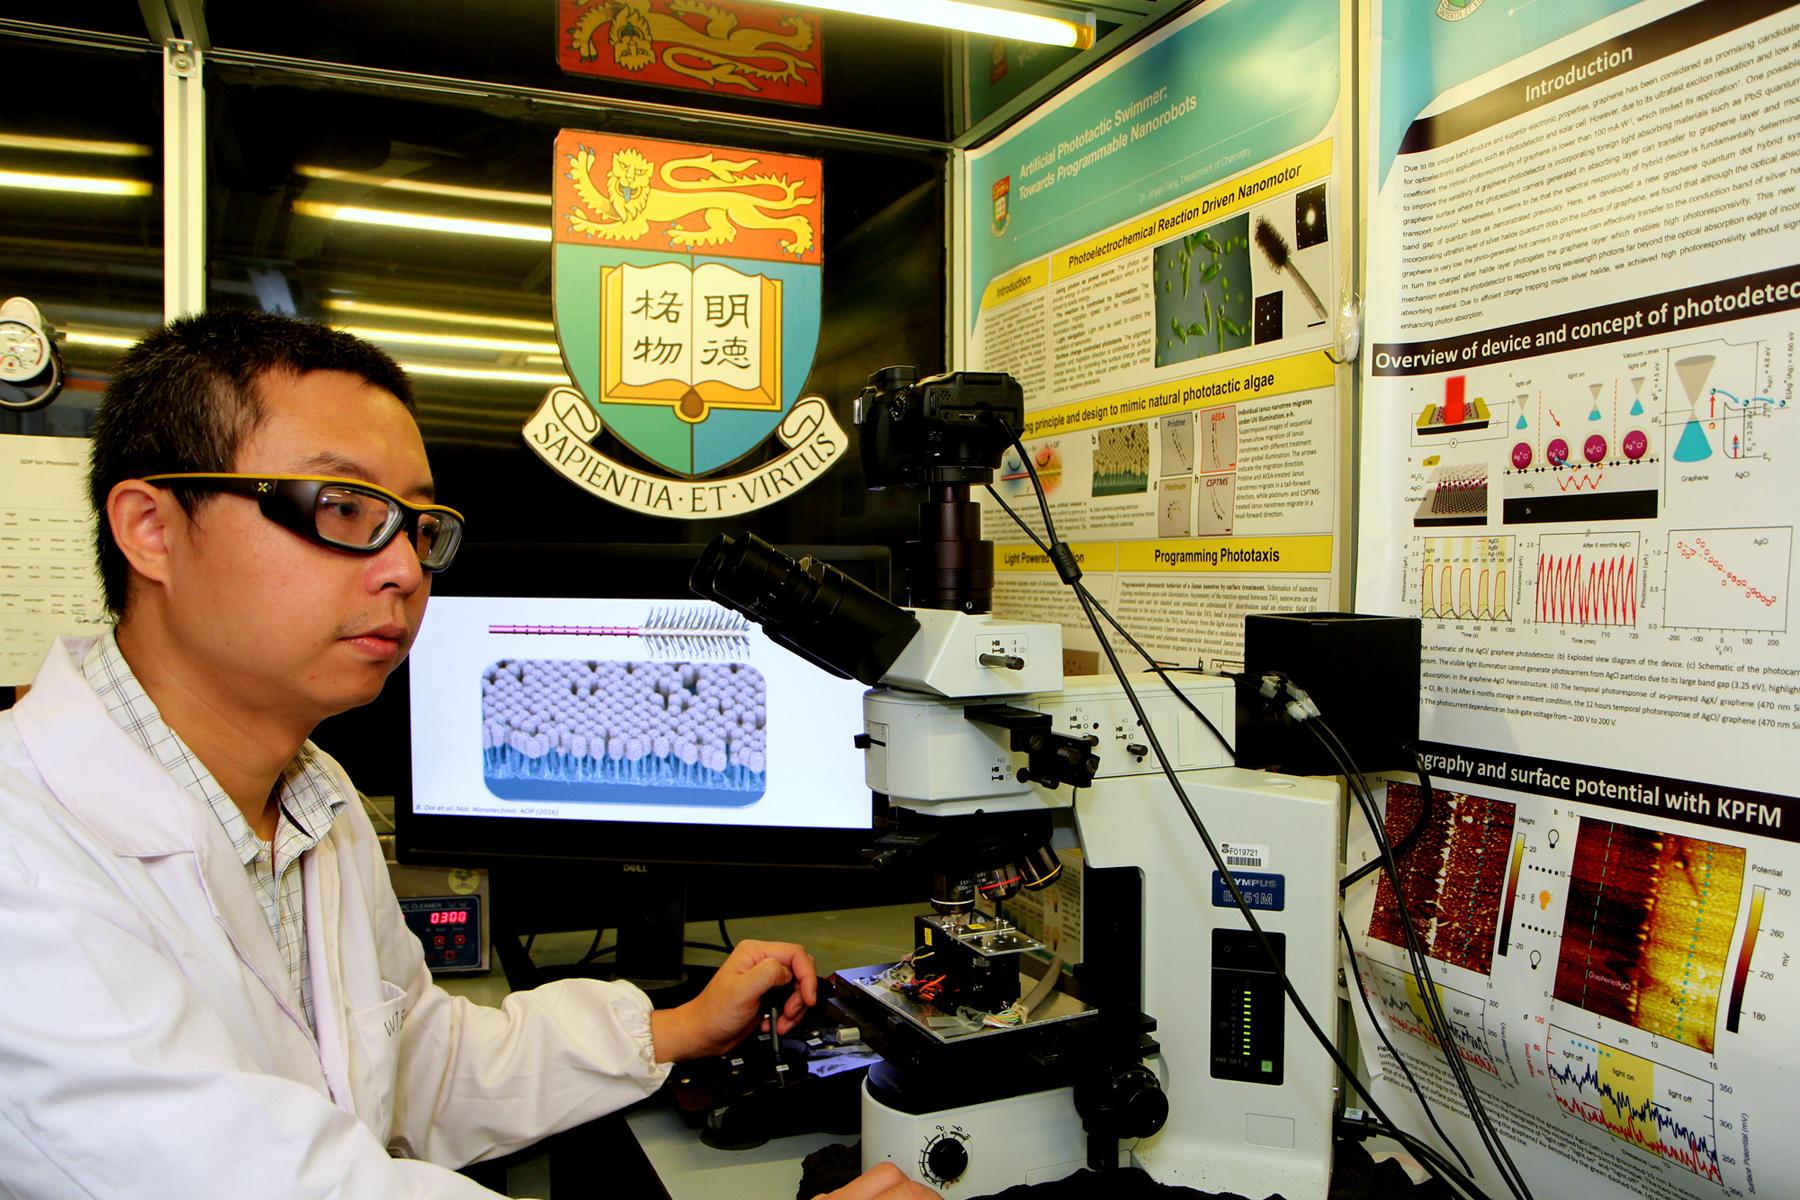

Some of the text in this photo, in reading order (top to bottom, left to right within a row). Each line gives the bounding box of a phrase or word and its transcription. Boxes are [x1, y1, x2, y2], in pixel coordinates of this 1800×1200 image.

[1525, 46, 1633, 102] Introduction
[1404, 165, 1418, 173] Due
[1437, 155, 1455, 166] unique
[1456, 150, 1468, 159] band
[1470, 141, 1492, 154] structure
[1493, 135, 1504, 145] and
[1505, 127, 1527, 141] superior
[1529, 117, 1557, 131] electronic
[1558, 103, 1591, 122] properties,
[1593, 90, 1624, 108] graphene
[1626, 85, 1638, 95] has
[1640, 77, 1658, 89] been
[1660, 60, 1700, 82] considered
[1704, 57, 1713, 65] as
[1716, 41, 1755, 61] promising
[1758, 23, 1800, 44] candidate
[1019, 86, 1167, 180] Artificial Phototactic Swimmer:
[1019, 95, 1197, 200] Towards Programmable Nanorobots
[1180, 163, 1213, 185] Department
[1214, 158, 1220, 170] of
[1221, 147, 1252, 167] Chemistry
[1068, 164, 1302, 268] Photoelectrochemical Reaction Driven Nanomotor
[997, 274, 1031, 298] Introduction
[631, 289, 684, 365] 格物
[699, 293, 753, 370] 明德
[1375, 281, 1800, 369] Overview of device and concept of photodetec
[1623, 348, 1659, 359] Vacuum Level
[1628, 362, 1639, 370] light
[1567, 372, 1578, 380] light
[1524, 379, 1532, 387] off
[1035, 415, 1064, 434] principle
[1066, 412, 1079, 424] and
[1082, 406, 1108, 423] design
[1110, 404, 1119, 416] to
[1120, 397, 1147, 415] mimic
[1148, 391, 1181, 409] natural
[1183, 378, 1241, 405] phototactic
[1244, 372, 1274, 391] algae
[1238, 407, 1258, 416] Individual
[1272, 402, 1291, 410] nanotree
[1292, 399, 1313, 408] migrates
[1211, 412, 1225, 421] AEEA
[1167, 419, 1186, 428] Pristine
[1239, 425, 1267, 435] Superimposed
[1290, 418, 1313, 428] sequential
[533, 421, 837, 514] SAPIENTIA ET VIRTUS
[1681, 474, 1709, 482] Graphene
[1735, 471, 1750, 479] AgCl
[1206, 478, 1228, 487] CSPTMS
[1753, 538, 1769, 546] AgCl
[1004, 552, 1020, 566] Light
[1154, 547, 1280, 566] Programming Phototaxis
[1430, 645, 1456, 653] schematic
[1491, 649, 1514, 658] graphene
[1557, 652, 1565, 661] (b)
[1567, 654, 1593, 662] Exploded
[1596, 655, 1609, 663] view
[1612, 656, 1636, 666] diagram
[1661, 660, 1683, 668] device.
[1687, 661, 1695, 670] (c)
[1698, 662, 1733, 672] Schematic
[1747, 666, 1759, 674] the
[1477, 760, 1507, 780] and
[1510, 767, 1571, 792] surface
[1575, 776, 1659, 807] potential
[1665, 789, 1711, 812] with
[1717, 798, 1782, 828] KPFM
[536, 808, 559, 816] (2016)
[1519, 817, 1535, 825] Height
[1230, 848, 1258, 856] F019721
[623, 864, 648, 872] DELL
[1752, 864, 1783, 877] Potential
[1220, 878, 1276, 888] OYMPUS
[1223, 890, 1273, 905] B51M
[1777, 887, 1792, 897] 300
[430, 911, 467, 924] 0300
[1770, 929, 1784, 939] 260
[1782, 952, 1790, 967] mV
[1760, 970, 1774, 980] 220
[1752, 1011, 1766, 1022] 180
[1563, 1050, 1583, 1063] light off
[1612, 1068, 1624, 1078] light
[1719, 1084, 1733, 1094] 350
[1668, 1089, 1693, 1103] light off
[1719, 1120, 1733, 1130] 300
[1722, 1155, 1735, 1165] 250
[1740, 1113, 1756, 1194] Surface Potential (mV)
